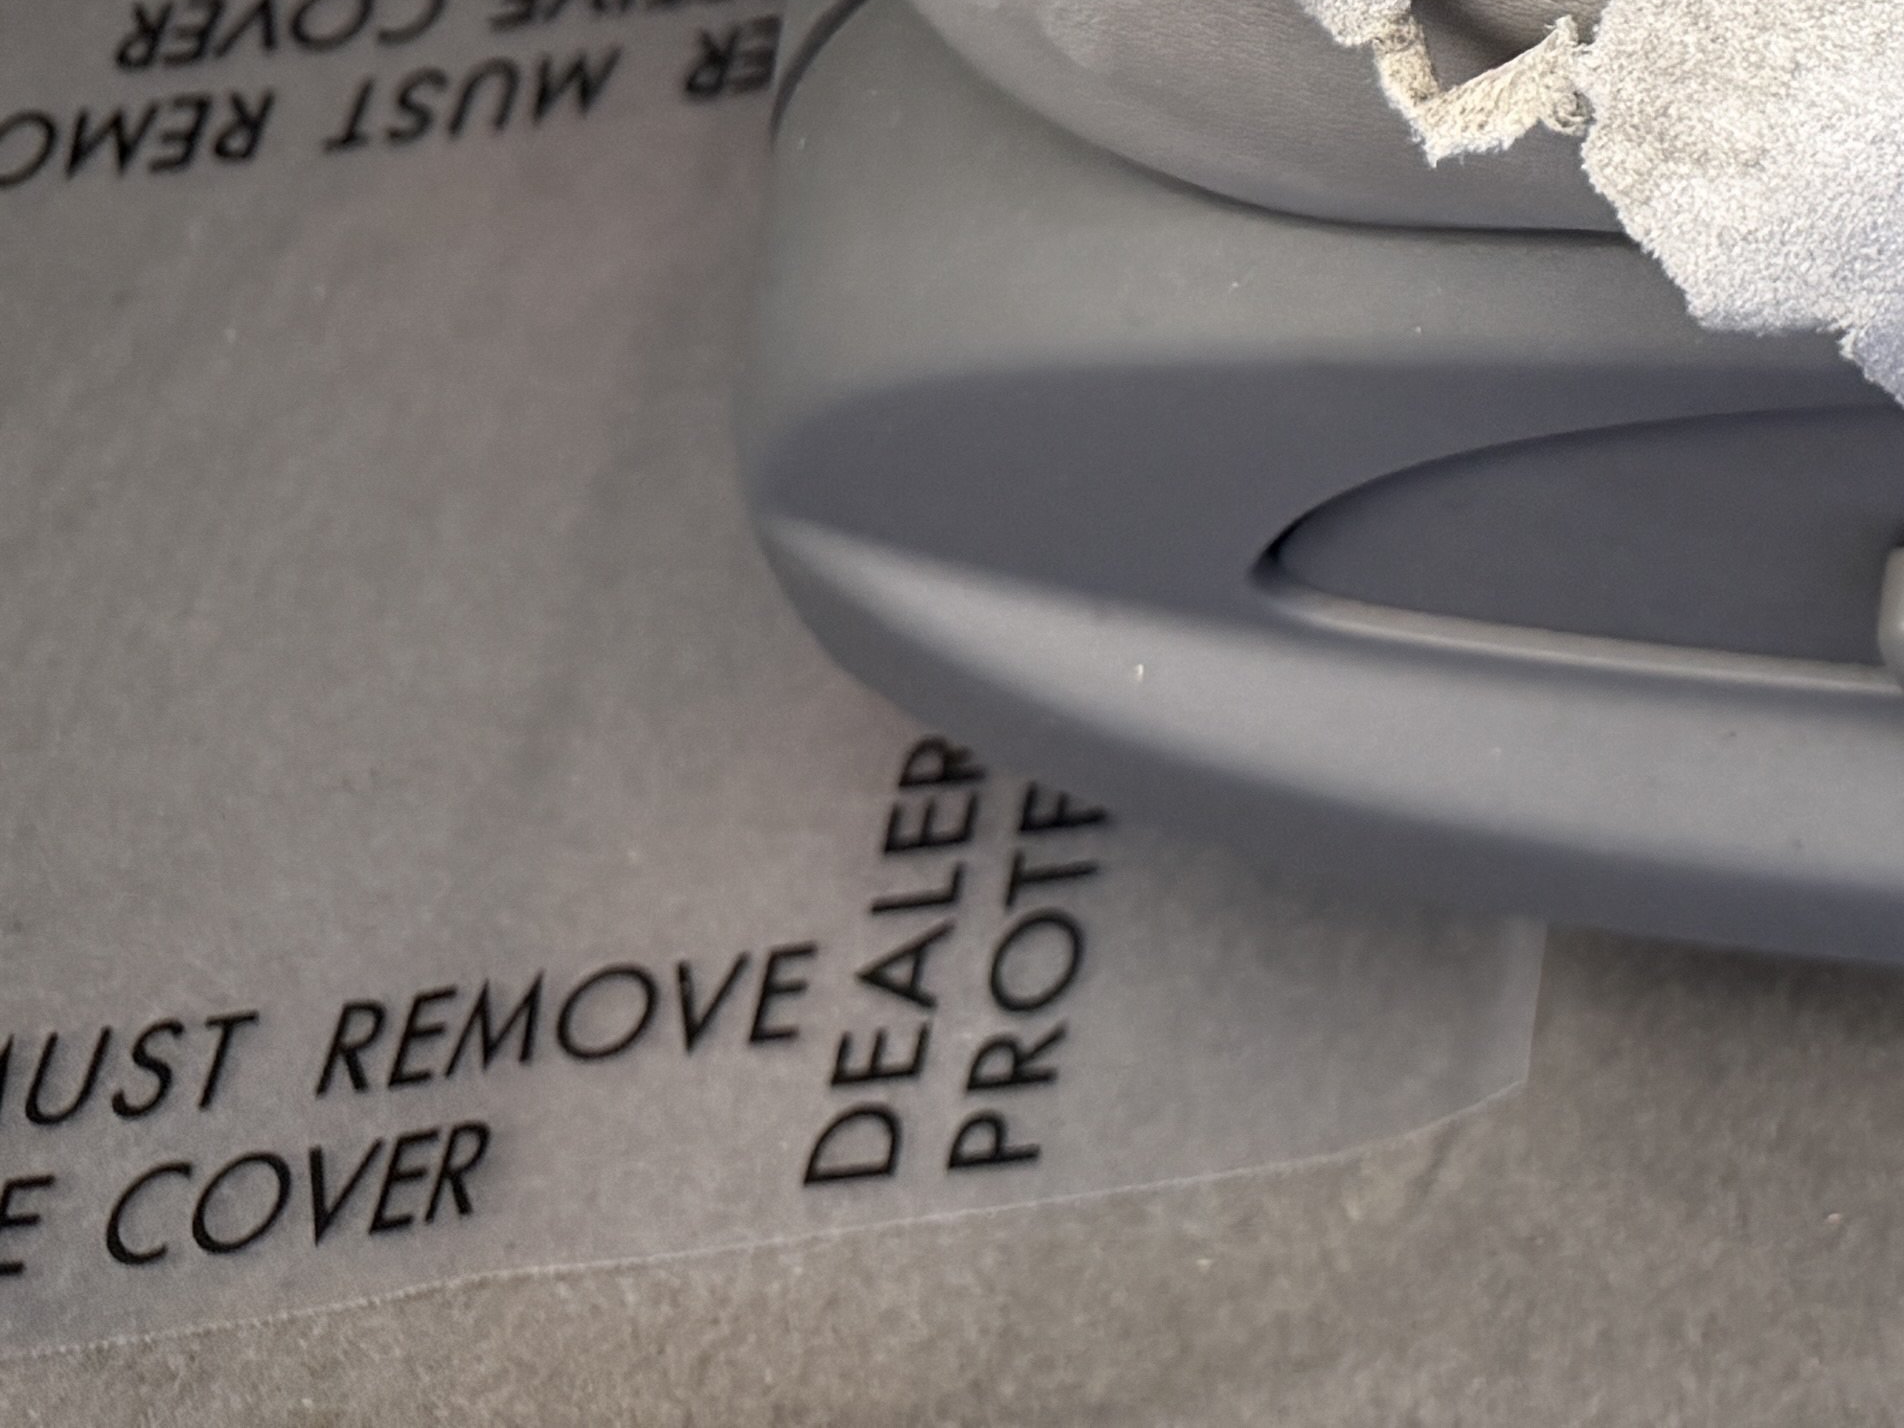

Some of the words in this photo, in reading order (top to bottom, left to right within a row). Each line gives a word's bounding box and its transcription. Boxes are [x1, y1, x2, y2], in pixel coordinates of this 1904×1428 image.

[323, 45, 622, 154] MUST
[0, 1008, 259, 1128] UST
[314, 942, 820, 1097] REMOVE
[803, 735, 989, 1188] DEALER
[103, 1120, 492, 1267] COVER
